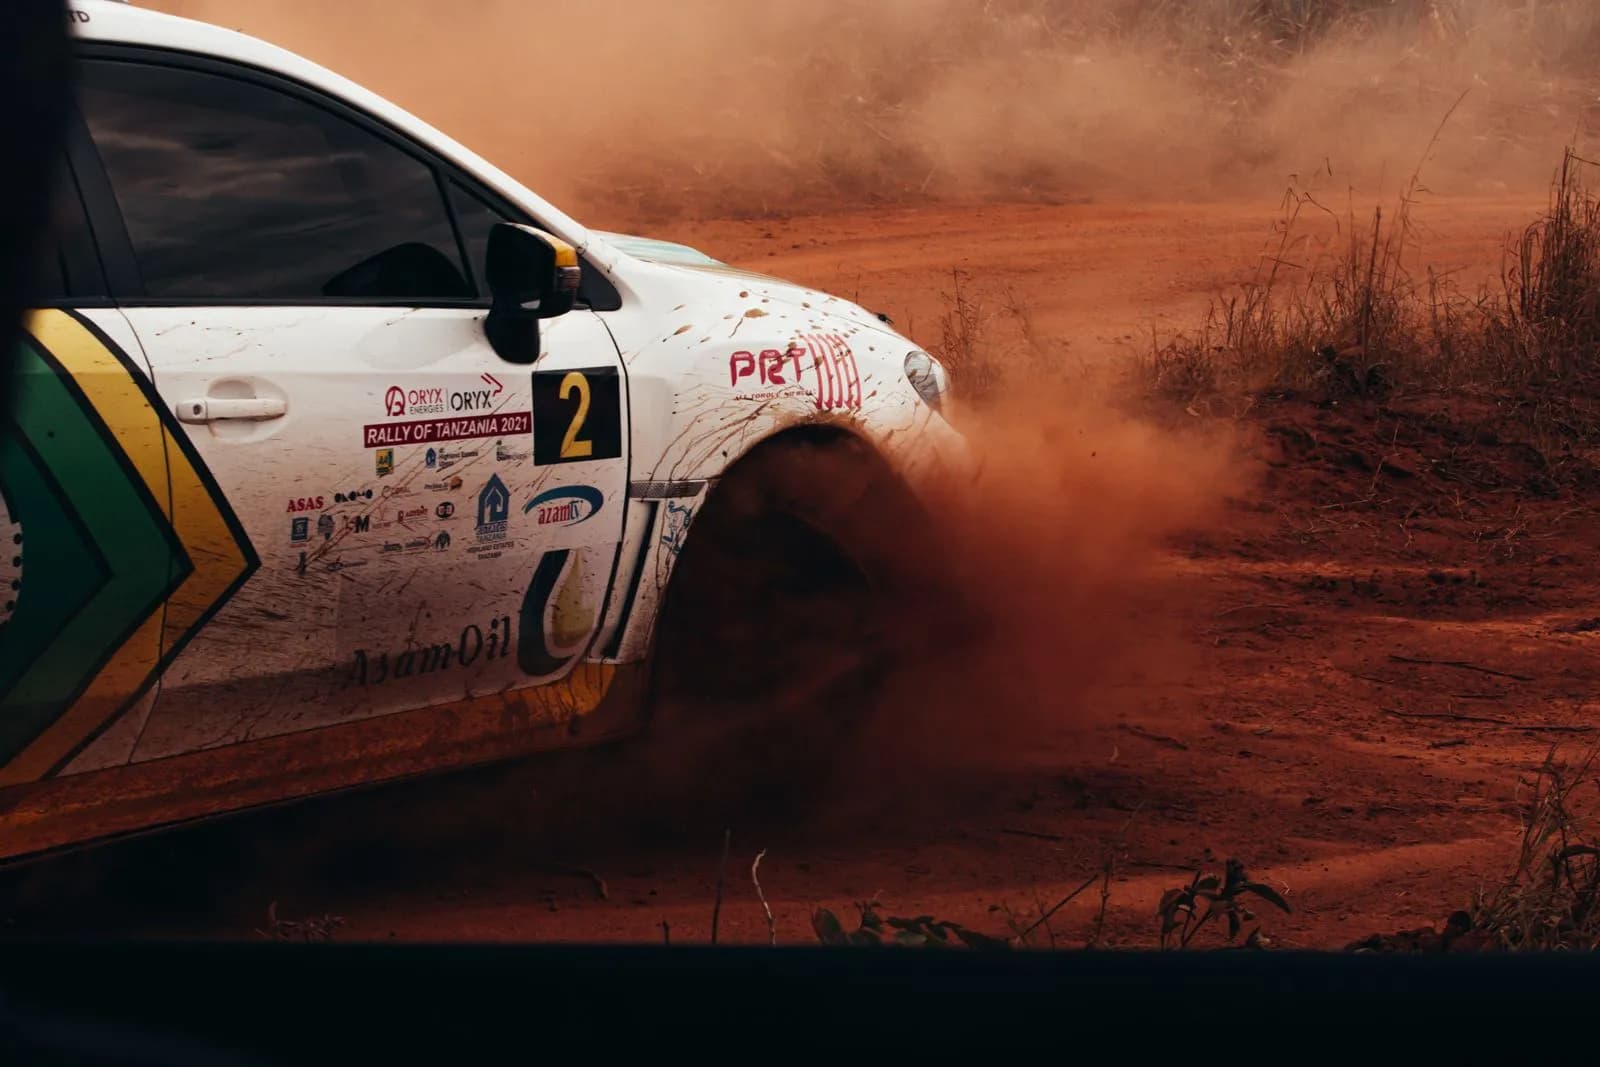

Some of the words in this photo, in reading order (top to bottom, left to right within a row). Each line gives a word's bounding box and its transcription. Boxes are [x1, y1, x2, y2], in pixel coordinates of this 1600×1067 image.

[729, 347, 806, 387] PRT
[408, 387, 443, 406] ORYX
[450, 390, 493, 412] ORYX
[409, 404, 445, 415] ENERGIES
[559, 371, 593, 458] 2
[367, 425, 409, 445] RALLY
[413, 422, 433, 441] OF
[435, 418, 499, 438] TANZANIA
[500, 415, 529, 433] 2021
[286, 496, 325, 513] ASAS
